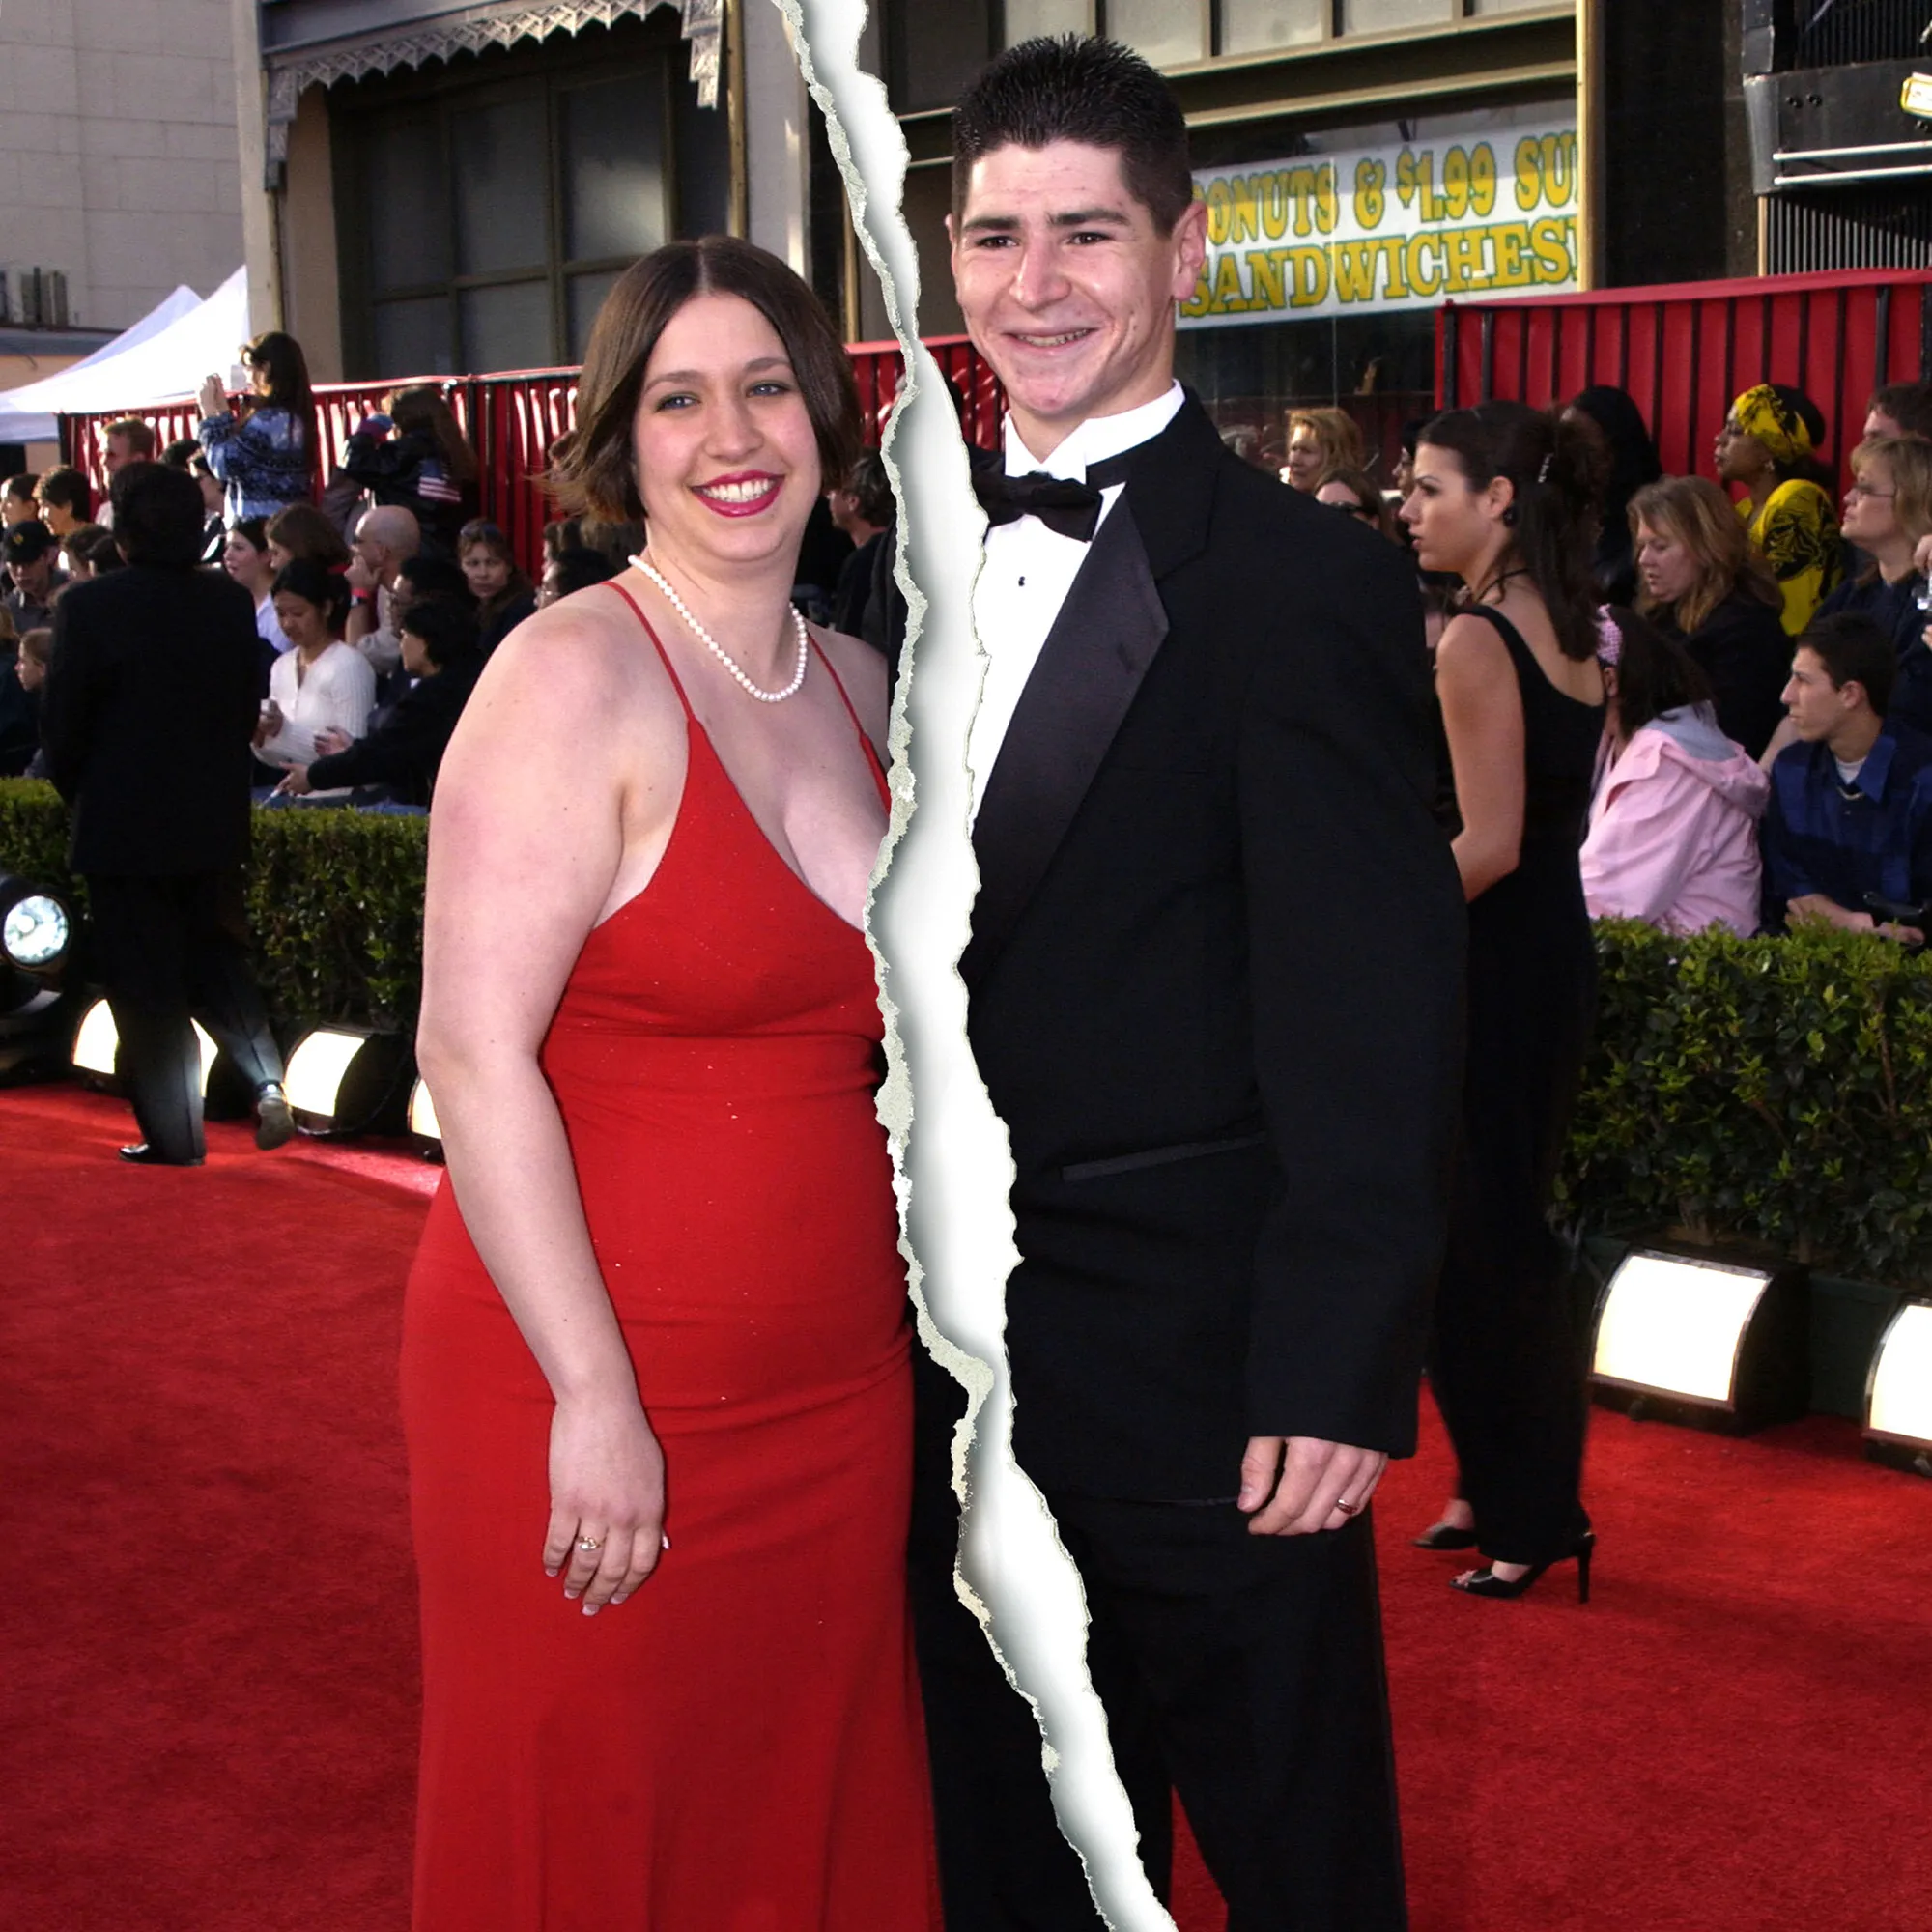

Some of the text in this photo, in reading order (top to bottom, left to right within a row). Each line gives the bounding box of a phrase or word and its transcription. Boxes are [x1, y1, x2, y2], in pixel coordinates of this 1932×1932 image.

[1354, 157, 1385, 231] &
[1396, 142, 1497, 223] $1.99
[1514, 129, 1577, 212] SU
